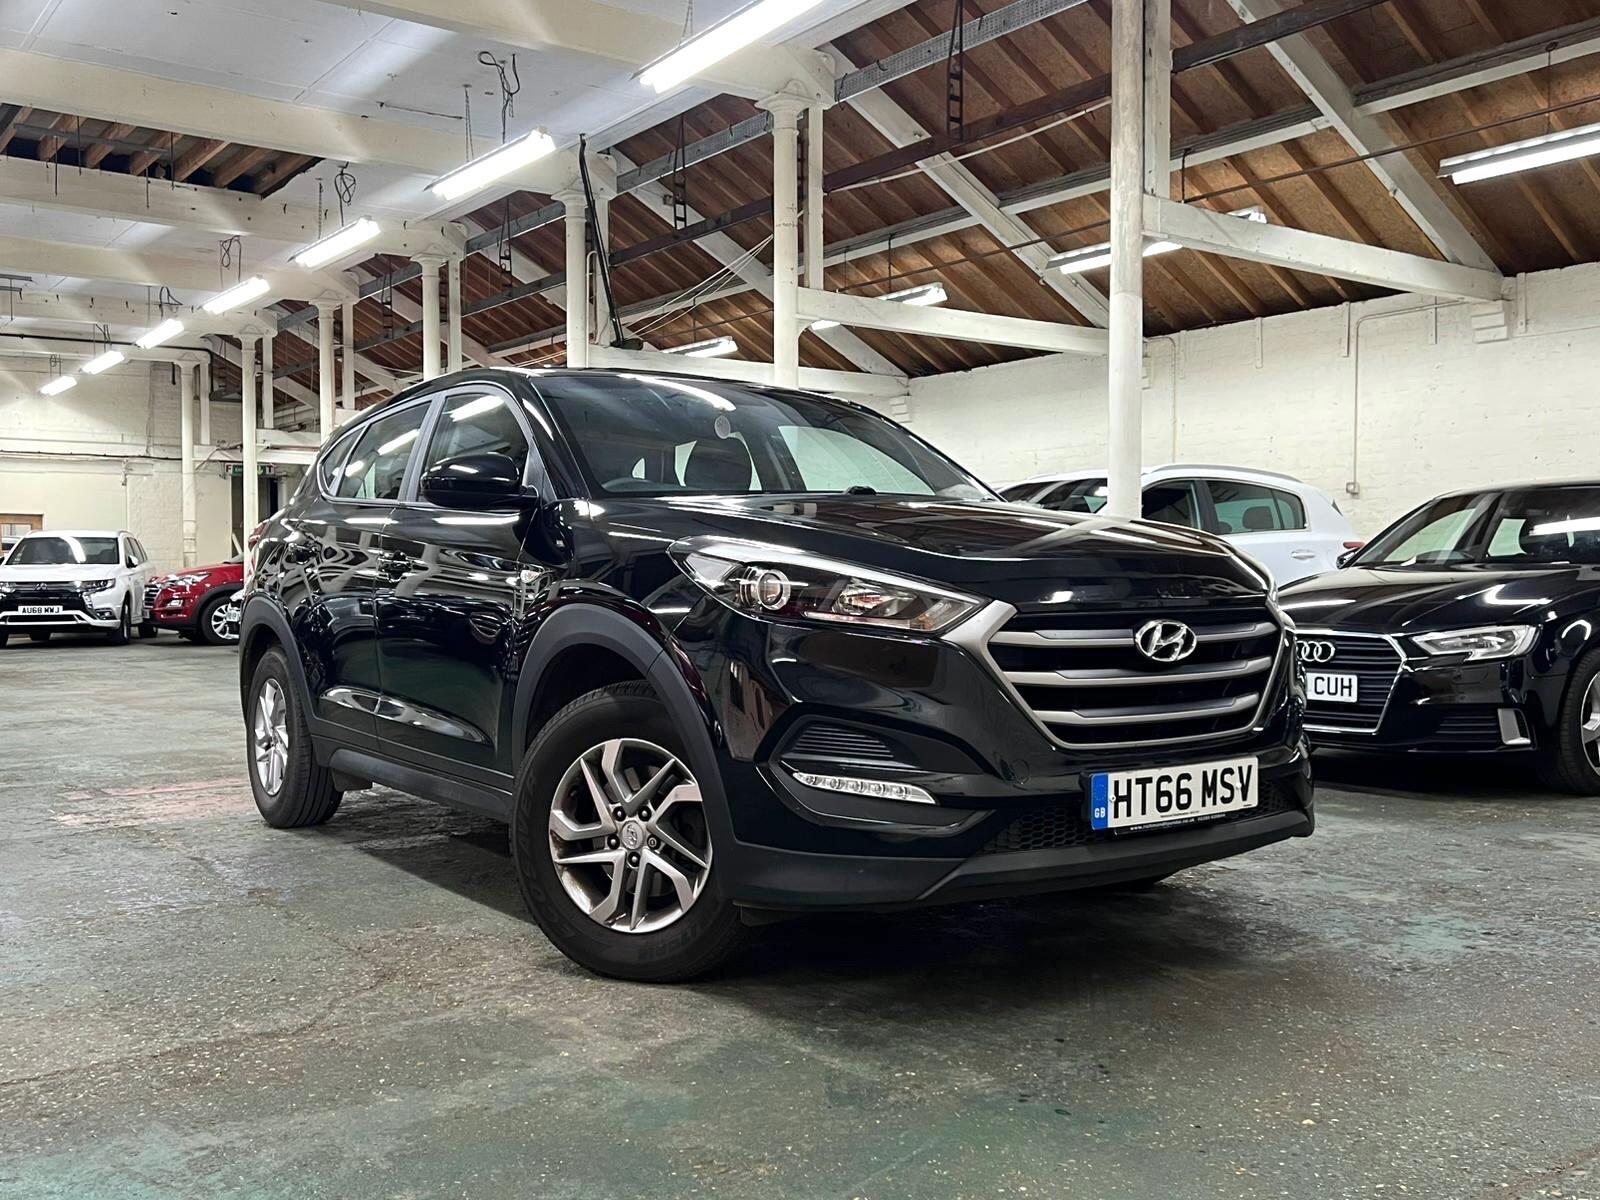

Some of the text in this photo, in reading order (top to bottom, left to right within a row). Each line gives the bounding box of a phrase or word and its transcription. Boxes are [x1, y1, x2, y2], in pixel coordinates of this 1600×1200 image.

[22, 606, 43, 614] AU68
[1314, 676, 1353, 697] CUH
[1113, 764, 1253, 819] HT66 MSV
[1094, 807, 1106, 819] GB
